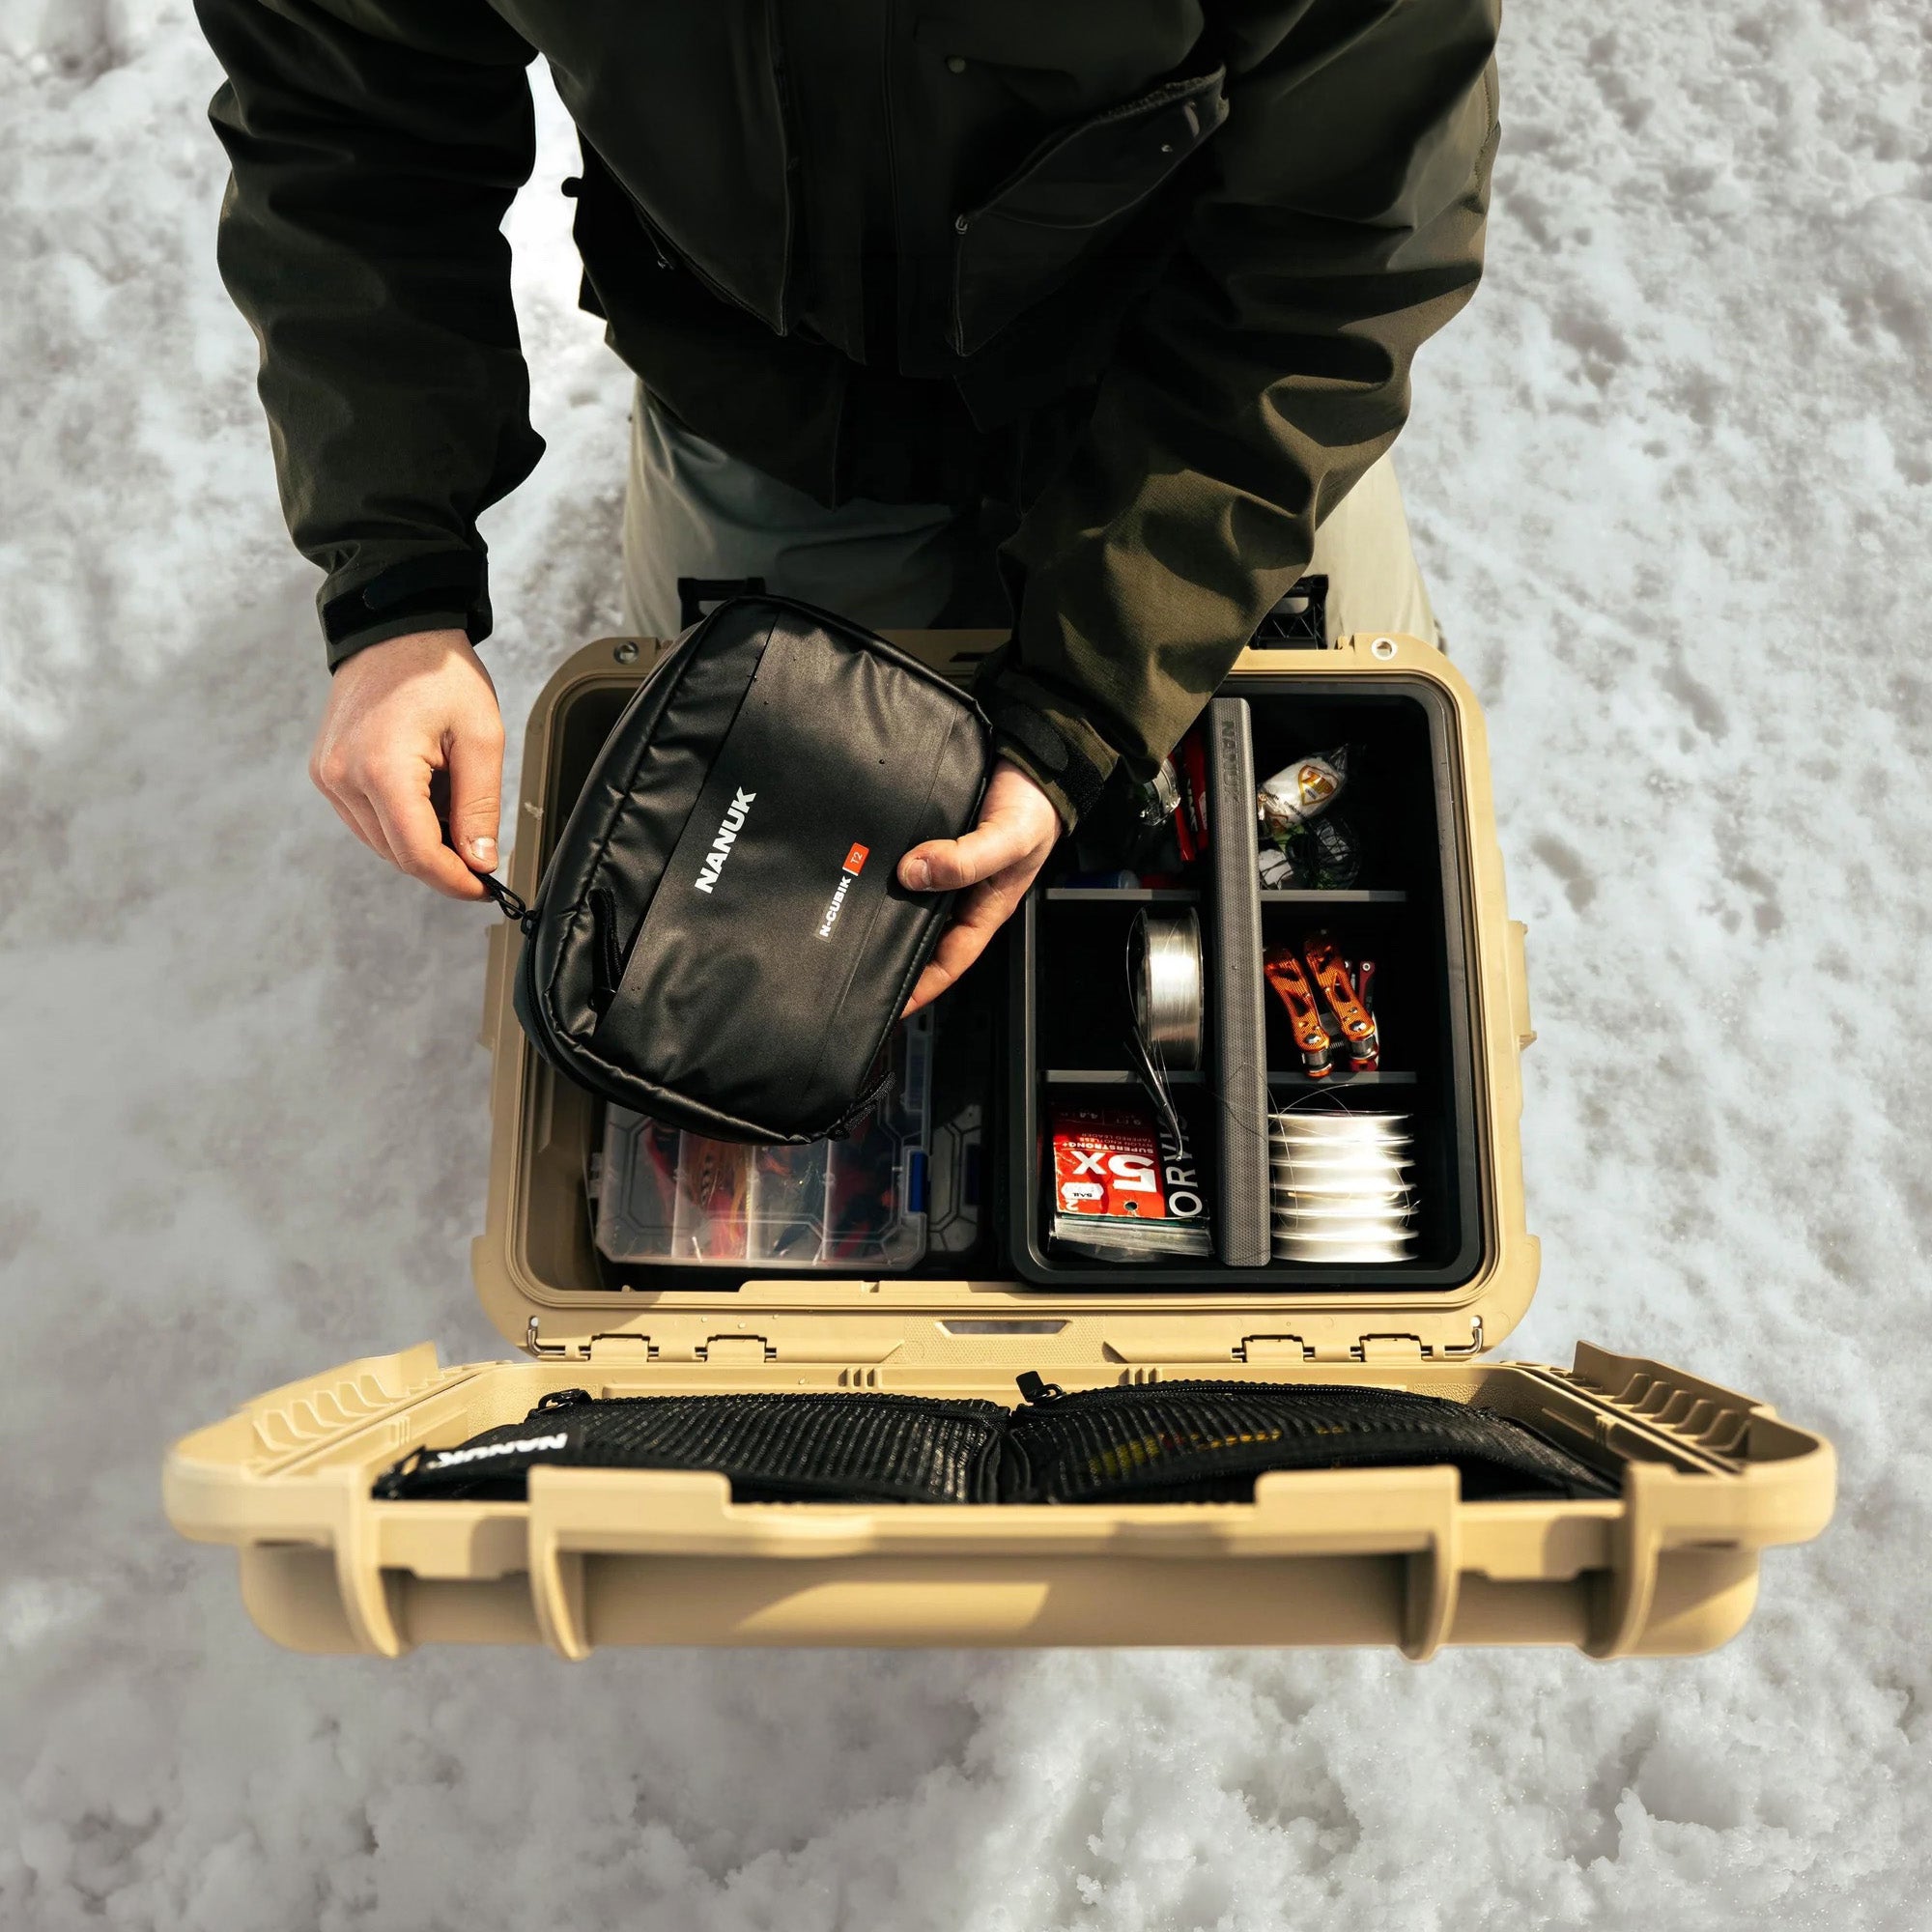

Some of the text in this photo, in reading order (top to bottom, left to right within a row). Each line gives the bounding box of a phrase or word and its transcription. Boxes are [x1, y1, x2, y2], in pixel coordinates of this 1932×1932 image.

[695, 786, 757, 895] NANUK
[819, 851, 863, 937] N-CUBIK T2
